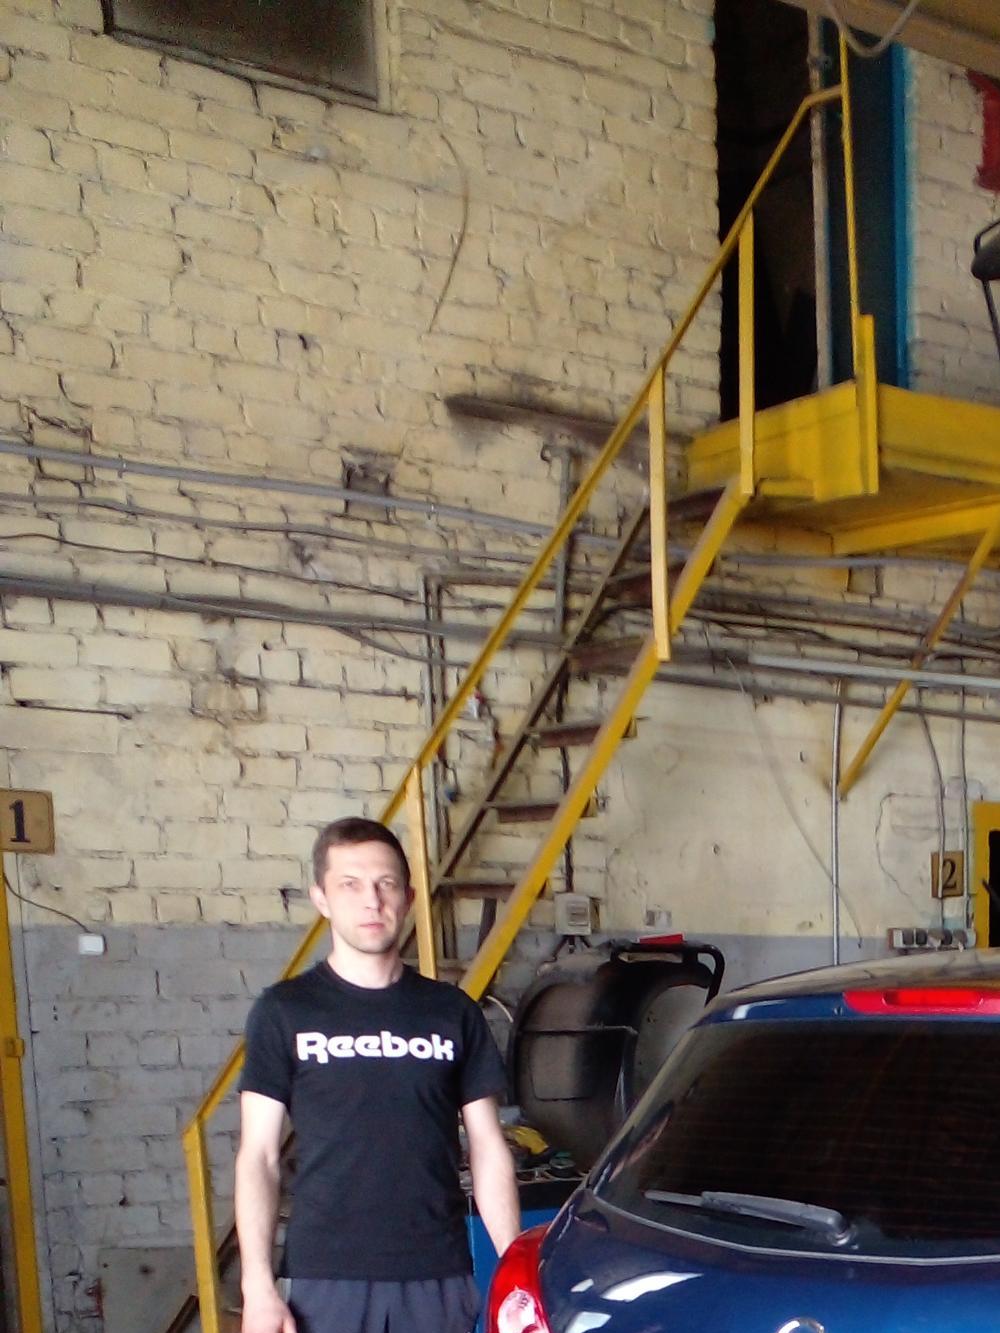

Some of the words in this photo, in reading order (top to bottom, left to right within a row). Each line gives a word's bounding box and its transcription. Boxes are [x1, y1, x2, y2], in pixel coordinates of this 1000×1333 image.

[9, 799, 31, 843] 1
[942, 857, 958, 889] 2
[296, 1031, 454, 1064] Reebok
